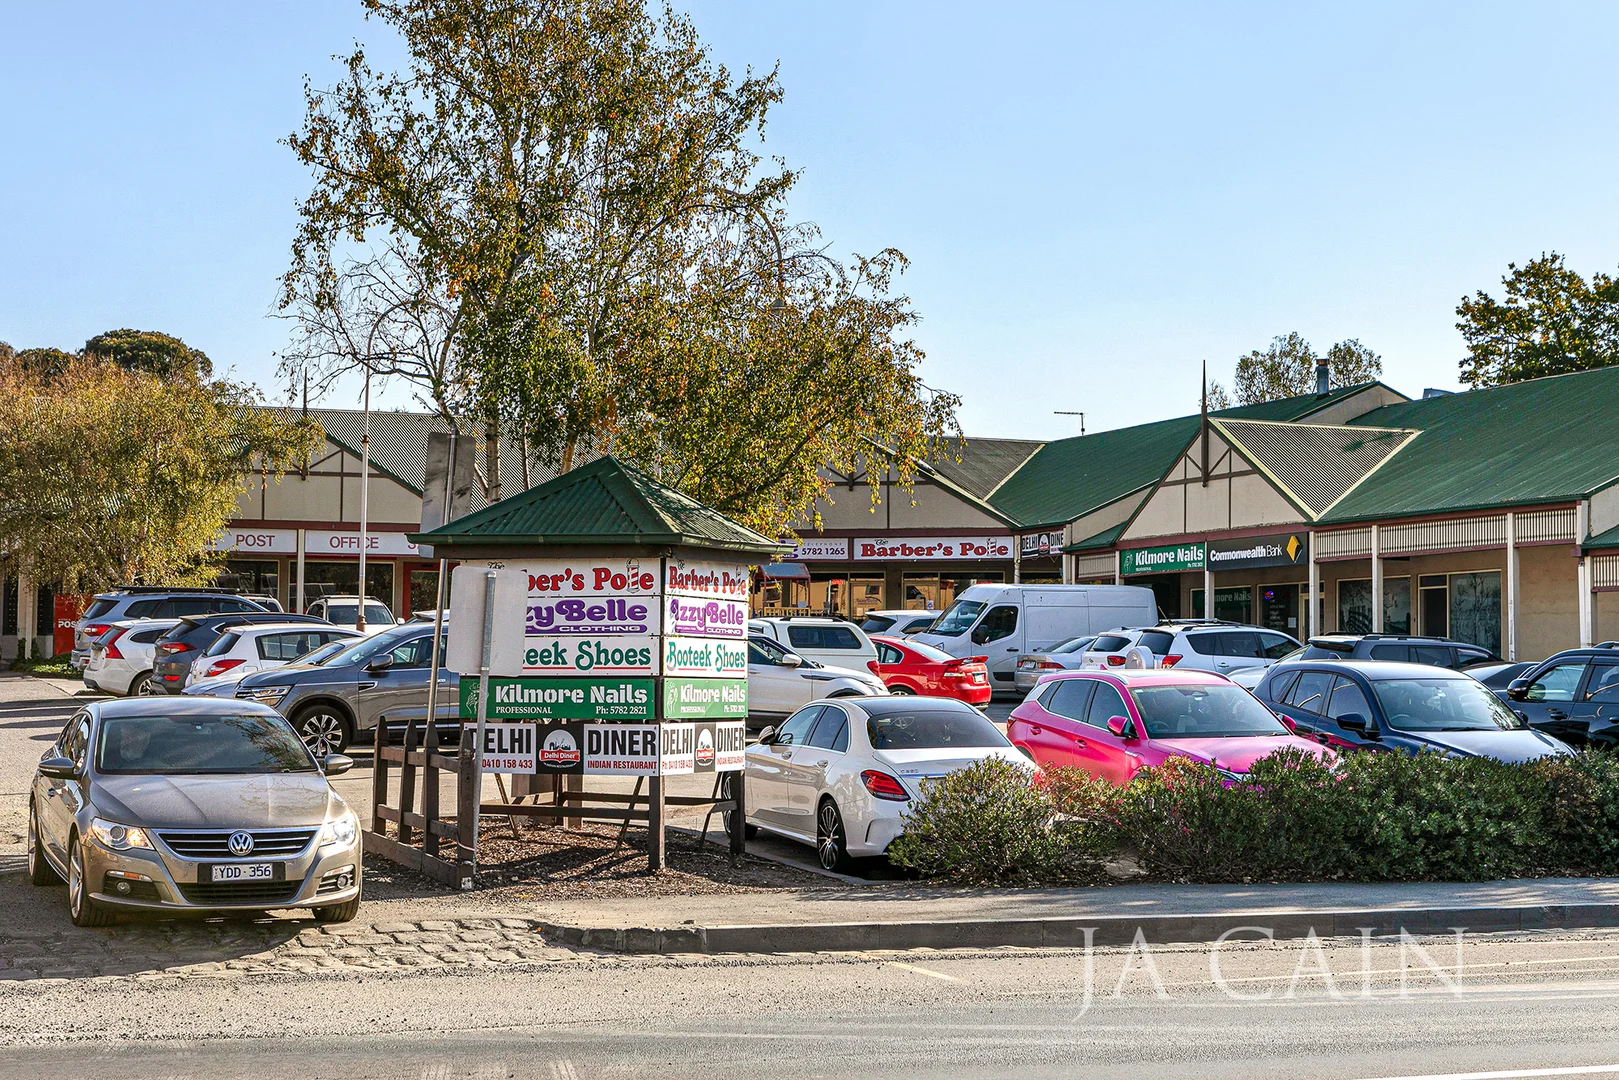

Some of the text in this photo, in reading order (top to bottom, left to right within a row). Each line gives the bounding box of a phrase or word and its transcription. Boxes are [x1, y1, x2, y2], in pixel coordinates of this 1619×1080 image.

[236, 534, 275, 547] POST
[1022, 533, 1063, 549] DELHI DINE
[825, 547, 845, 555] 1265
[861, 543, 953, 557] Barber's
[1135, 546, 1203, 566] Kilmore Nails
[1210, 544, 1282, 561] Commonwealth Bank
[669, 566, 719, 593] Barber's
[58, 620, 78, 629] POS
[574, 641, 651, 670] Shoes
[667, 642, 745, 672] Booteek Shoes
[495, 684, 647, 704] Kilmore Nails
[681, 684, 746, 703] Kilmore Nails
[495, 706, 552, 714] PROFESSIONAL
[595, 706, 647, 714] Ph: 5782 2821
[588, 730, 656, 755] DINER
[662, 728, 693, 755] DELHI
[717, 727, 744, 752] DINER
[482, 759, 500, 769] 0410
[503, 759, 516, 769] 158
[519, 759, 533, 769] 433
[588, 760, 657, 769] INDIAN RESTAURANT
[219, 866, 271, 878] YDD 356
